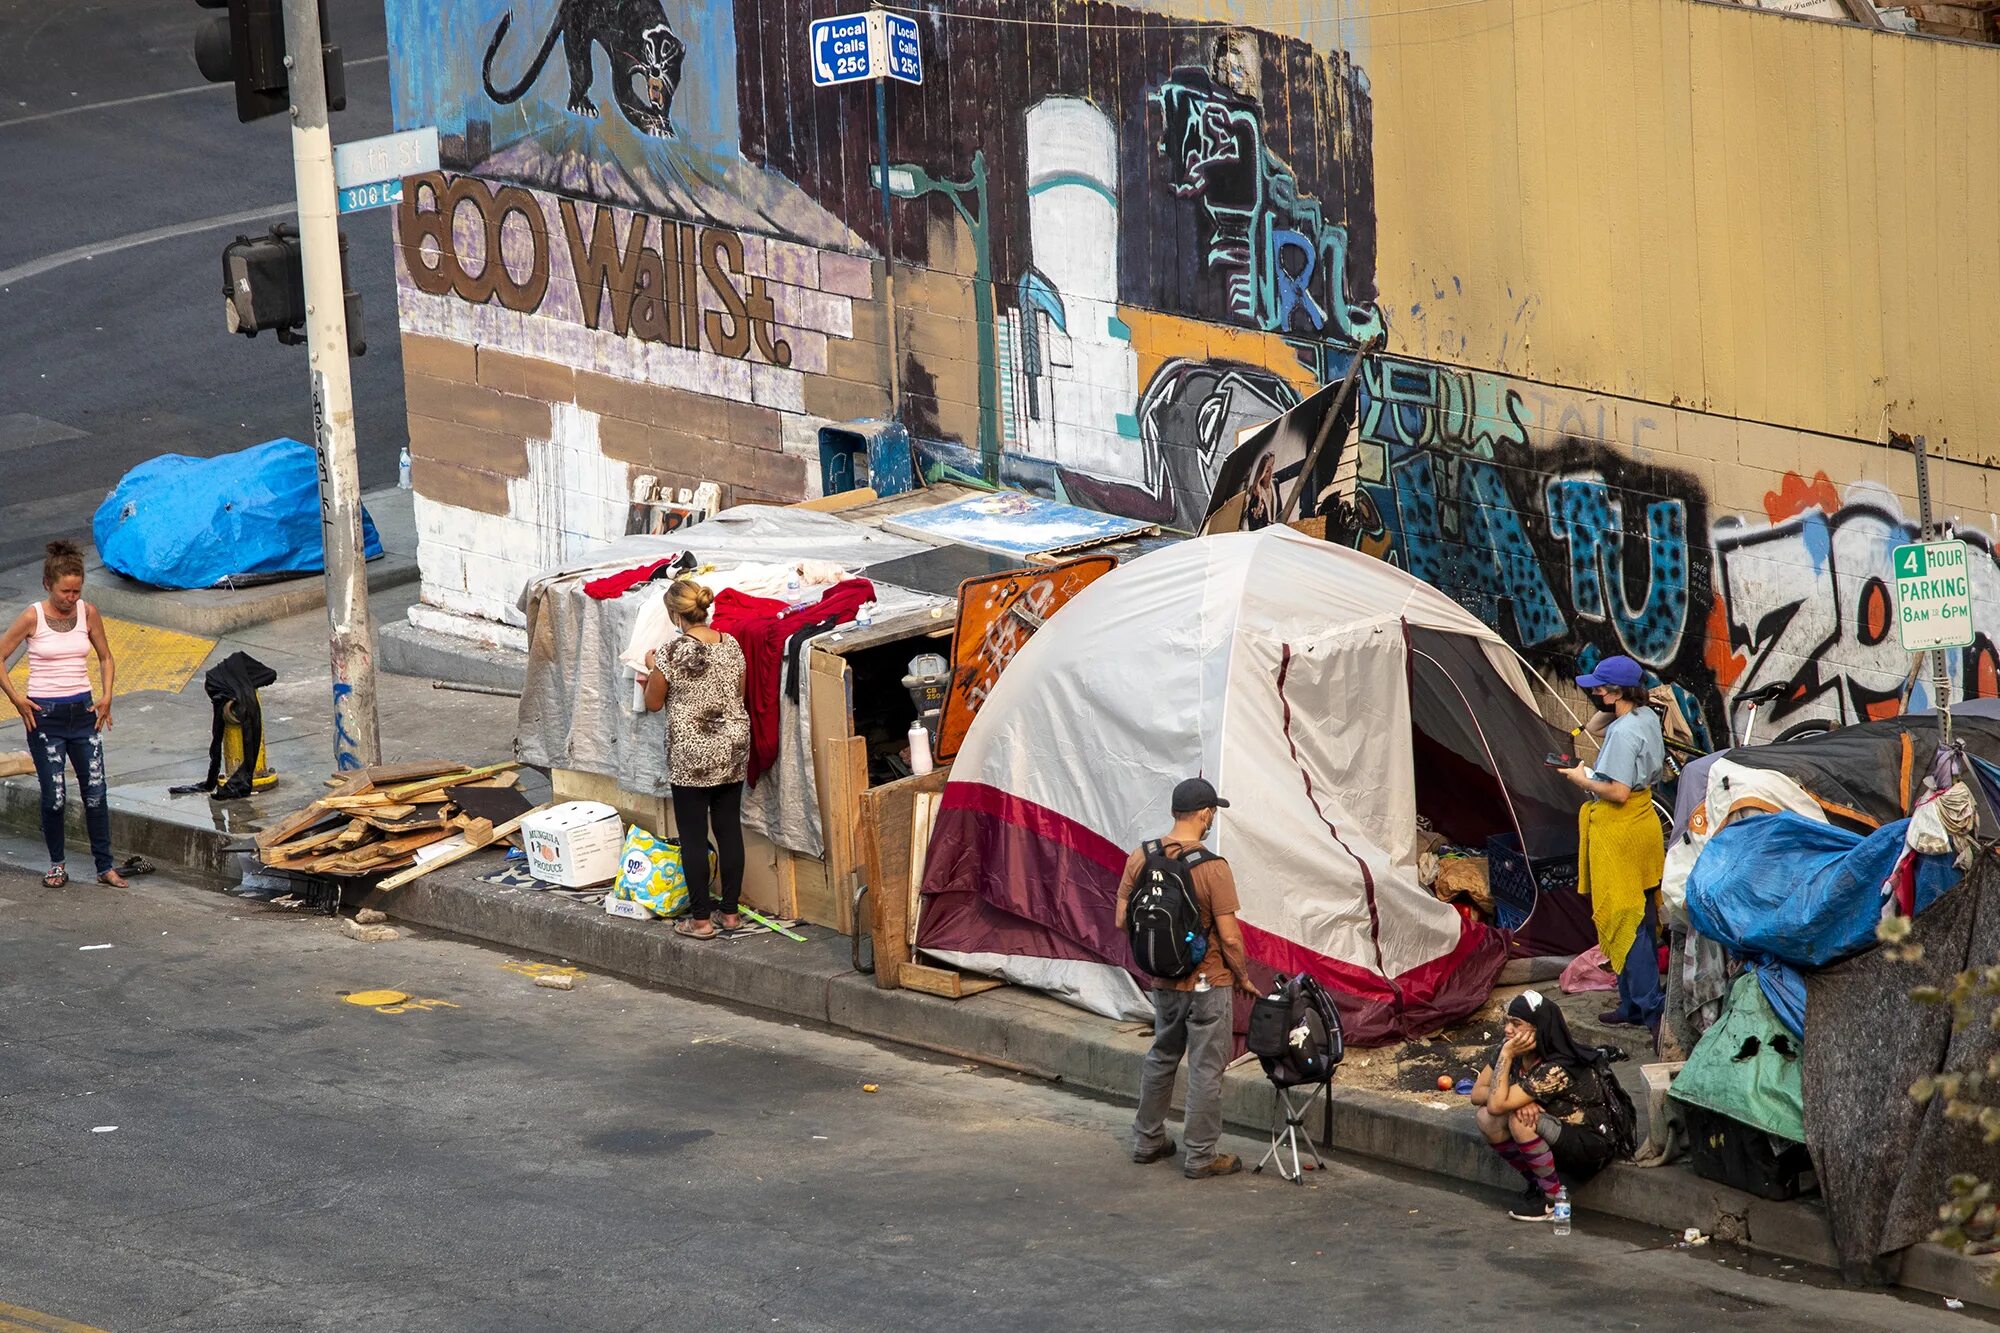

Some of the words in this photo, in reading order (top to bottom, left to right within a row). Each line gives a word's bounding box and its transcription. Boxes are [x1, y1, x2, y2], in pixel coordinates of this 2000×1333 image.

[832, 21, 866, 39] Local
[897, 23, 917, 40] Local
[834, 39, 866, 55] Calls
[899, 40, 917, 57] Calls
[837, 57, 867, 74] 25¢
[399, 138, 423, 168] St
[348, 186, 378, 209] 300
[382, 182, 392, 202] E
[397, 170, 549, 315] 600
[557, 195, 700, 351] Wall
[1903, 551, 1918, 573] 4
[1928, 549, 1963, 568] HOUR
[1900, 577, 1966, 602] PARKING
[1903, 606, 1930, 623] 8AM
[1941, 603, 1968, 619] 6PM
[528, 830, 560, 846] MUNGUIA
[533, 859, 564, 873] PRODUCE
